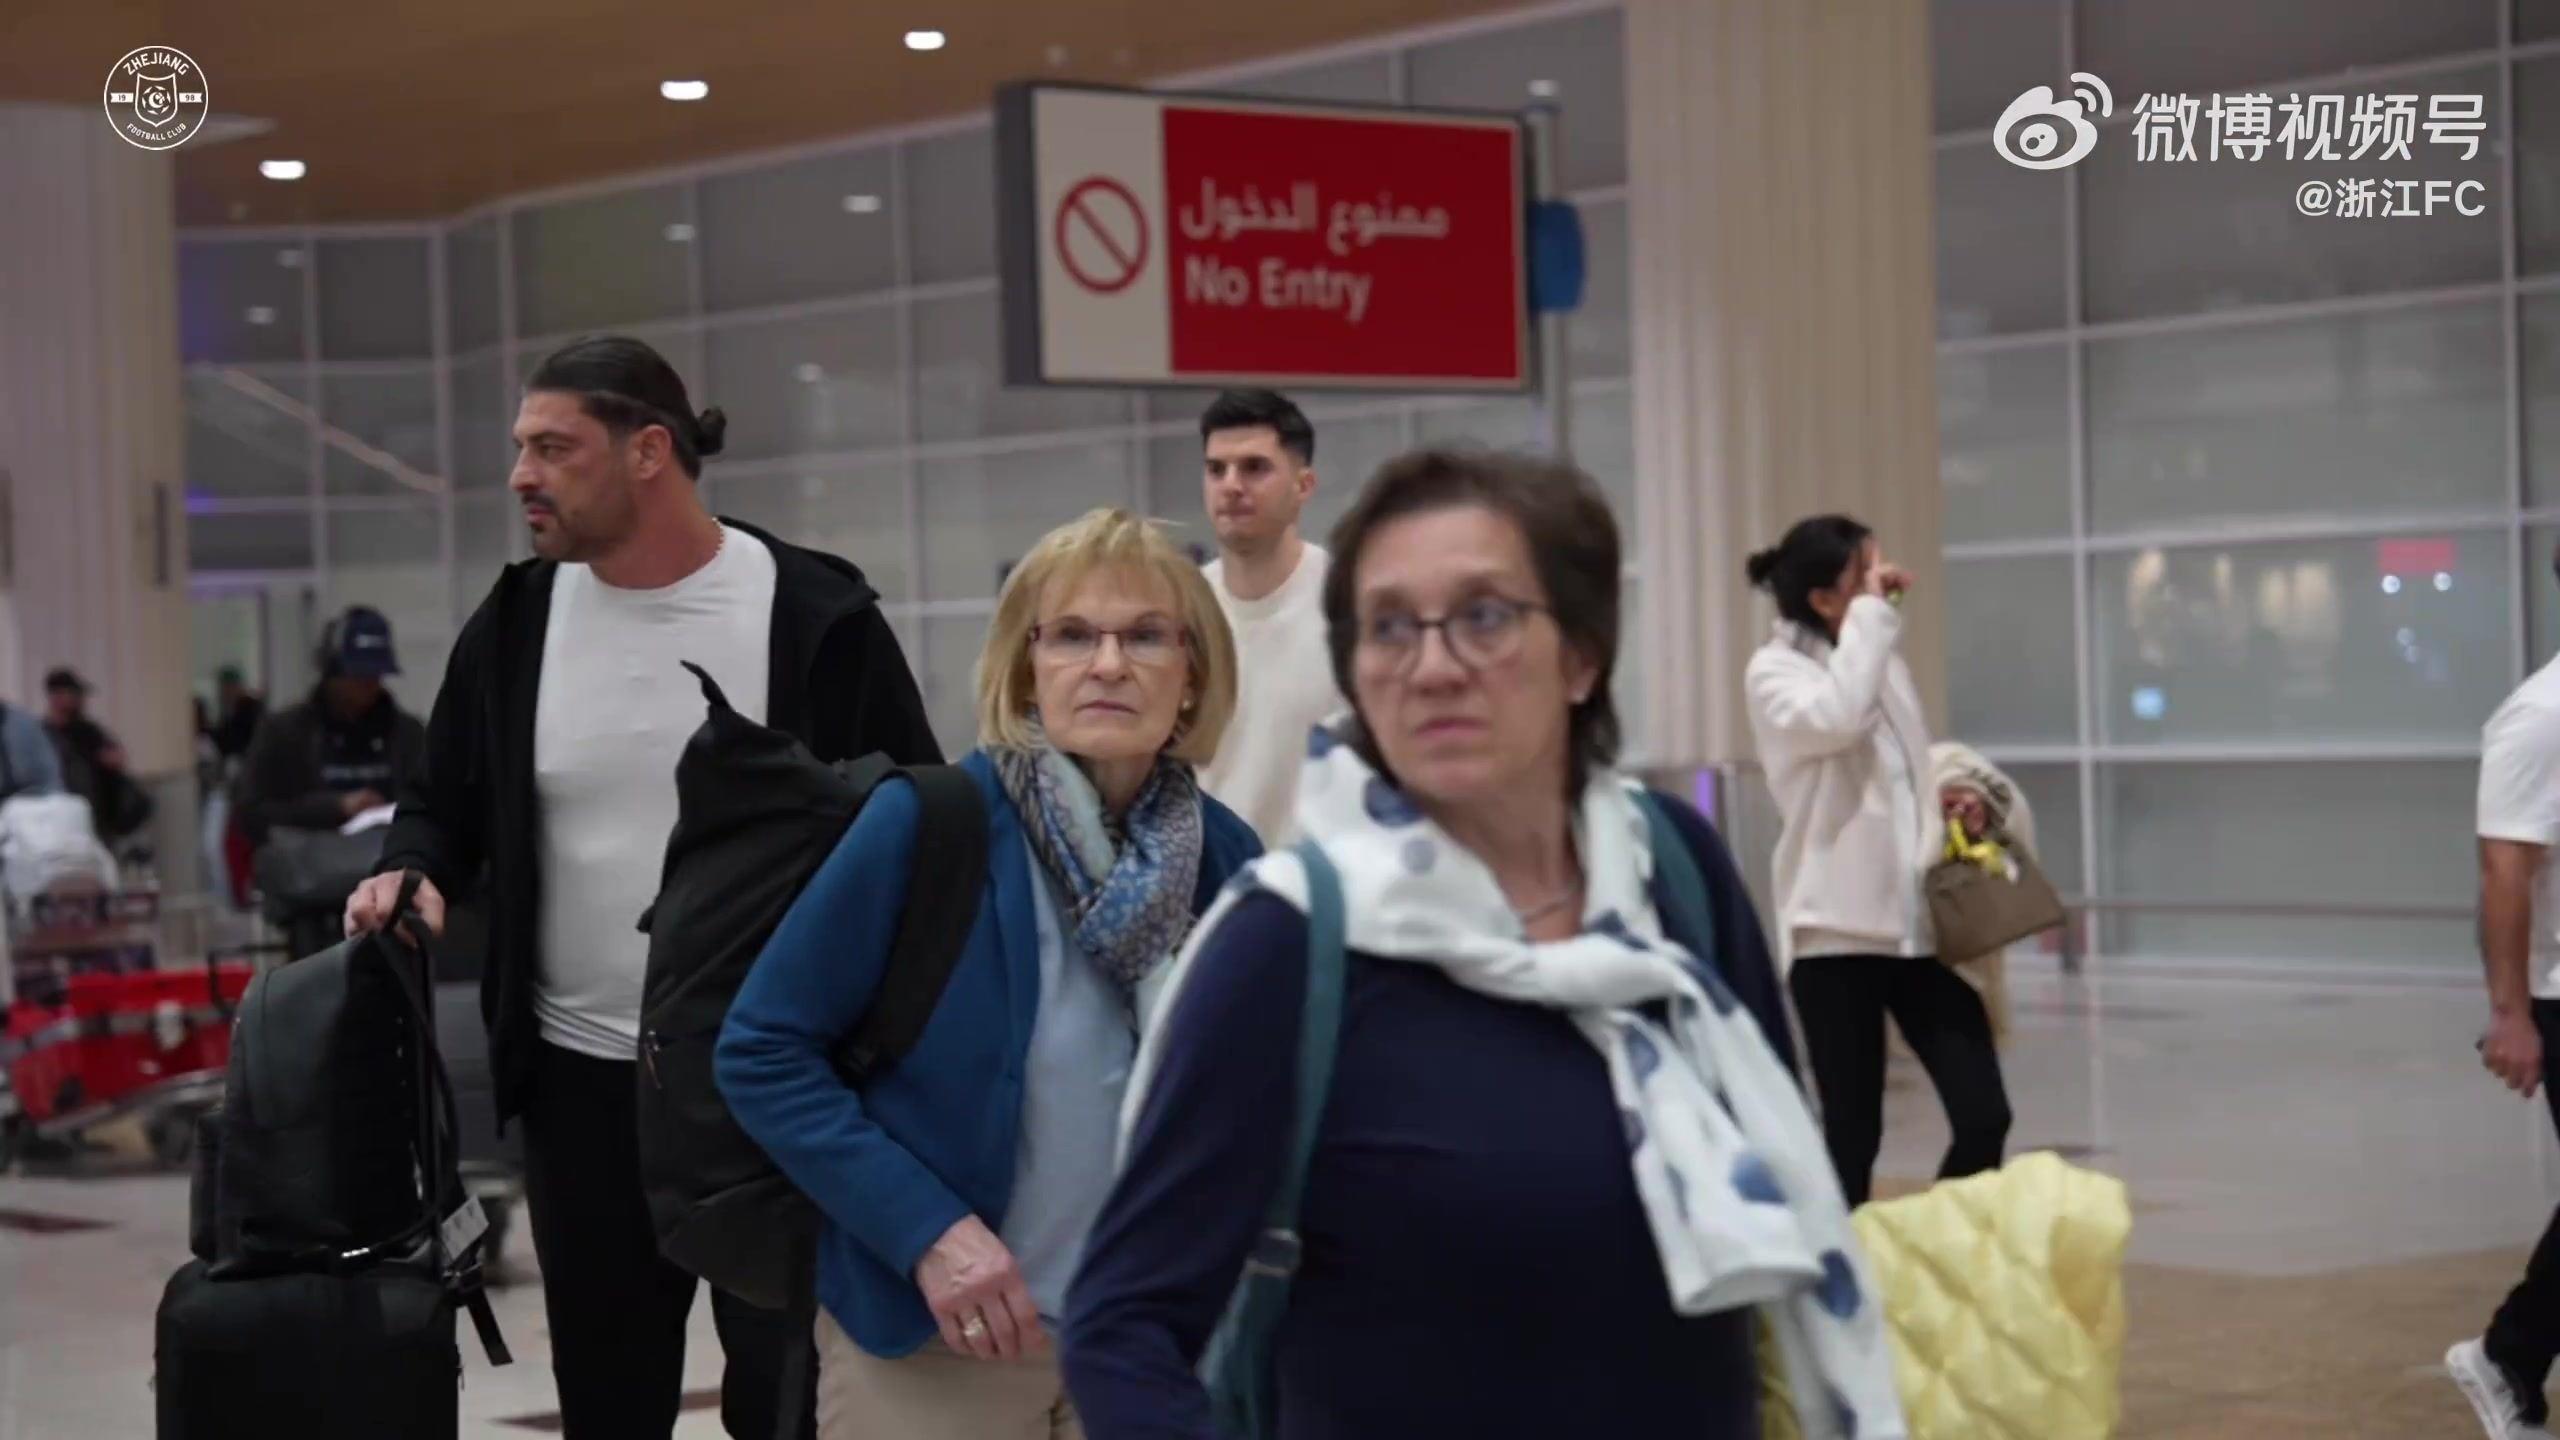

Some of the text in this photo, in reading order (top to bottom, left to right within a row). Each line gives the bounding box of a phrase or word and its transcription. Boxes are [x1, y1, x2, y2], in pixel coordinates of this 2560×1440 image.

[1179, 177, 1451, 255] ممنوع الدخول
[1184, 256, 1374, 323] No Entry
